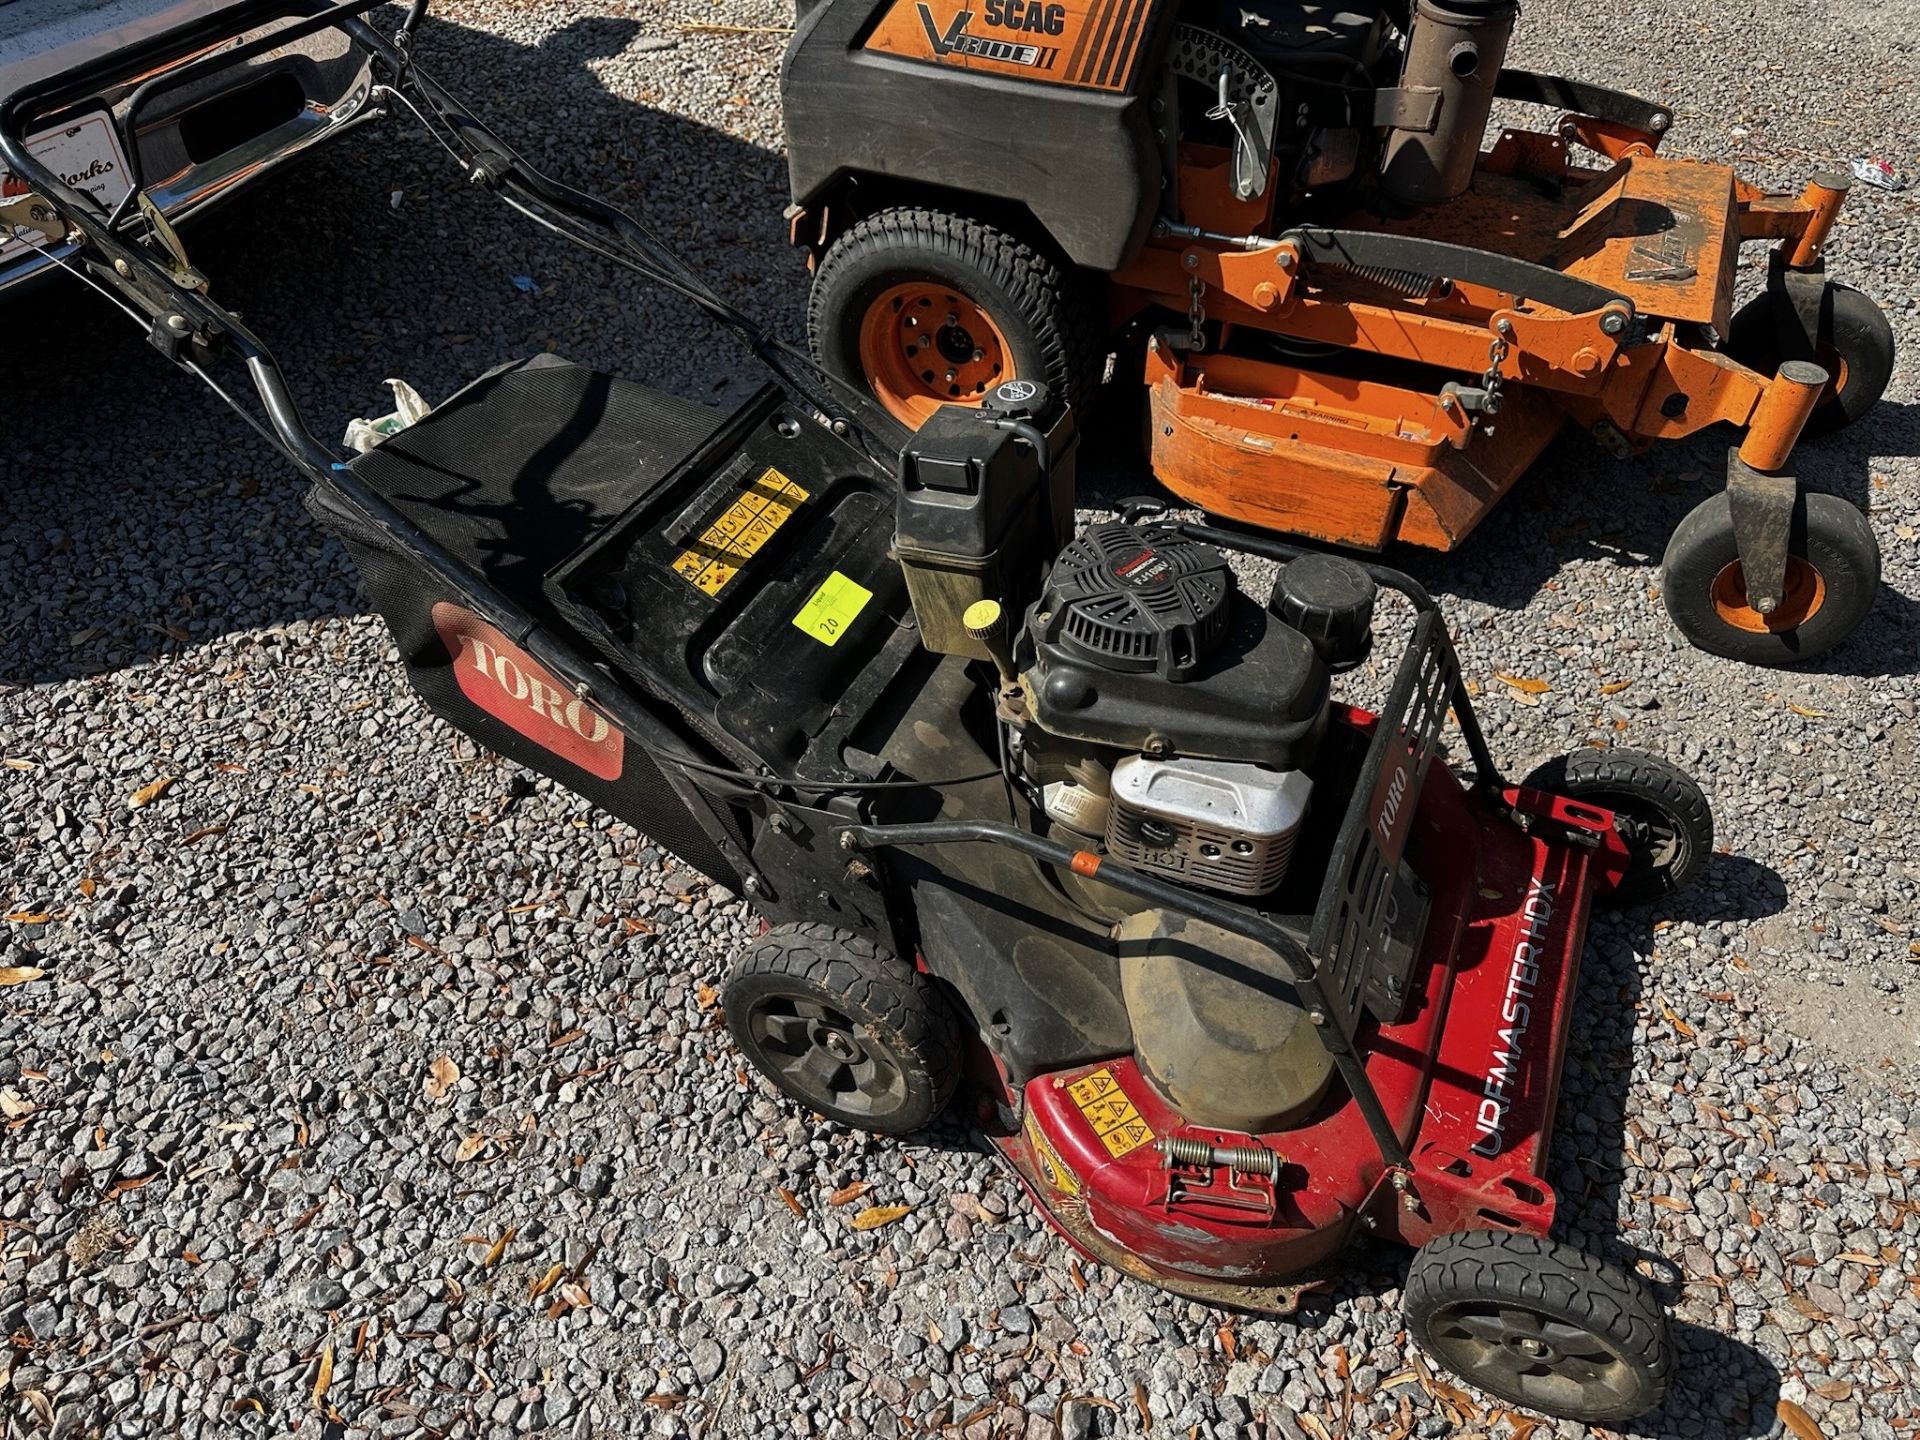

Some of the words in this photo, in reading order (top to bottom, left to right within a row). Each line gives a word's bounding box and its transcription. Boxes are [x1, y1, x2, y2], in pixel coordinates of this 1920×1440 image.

[984, 0, 1066, 36] SCAG
[60, 159, 114, 186] orks
[819, 618, 839, 635] 20
[457, 633, 609, 743] TORO
[1377, 766, 1407, 843] TORO
[1143, 849, 1191, 870] HOT
[1470, 940, 1543, 1157] URFMASTER
[1520, 876, 1557, 940] HDX
